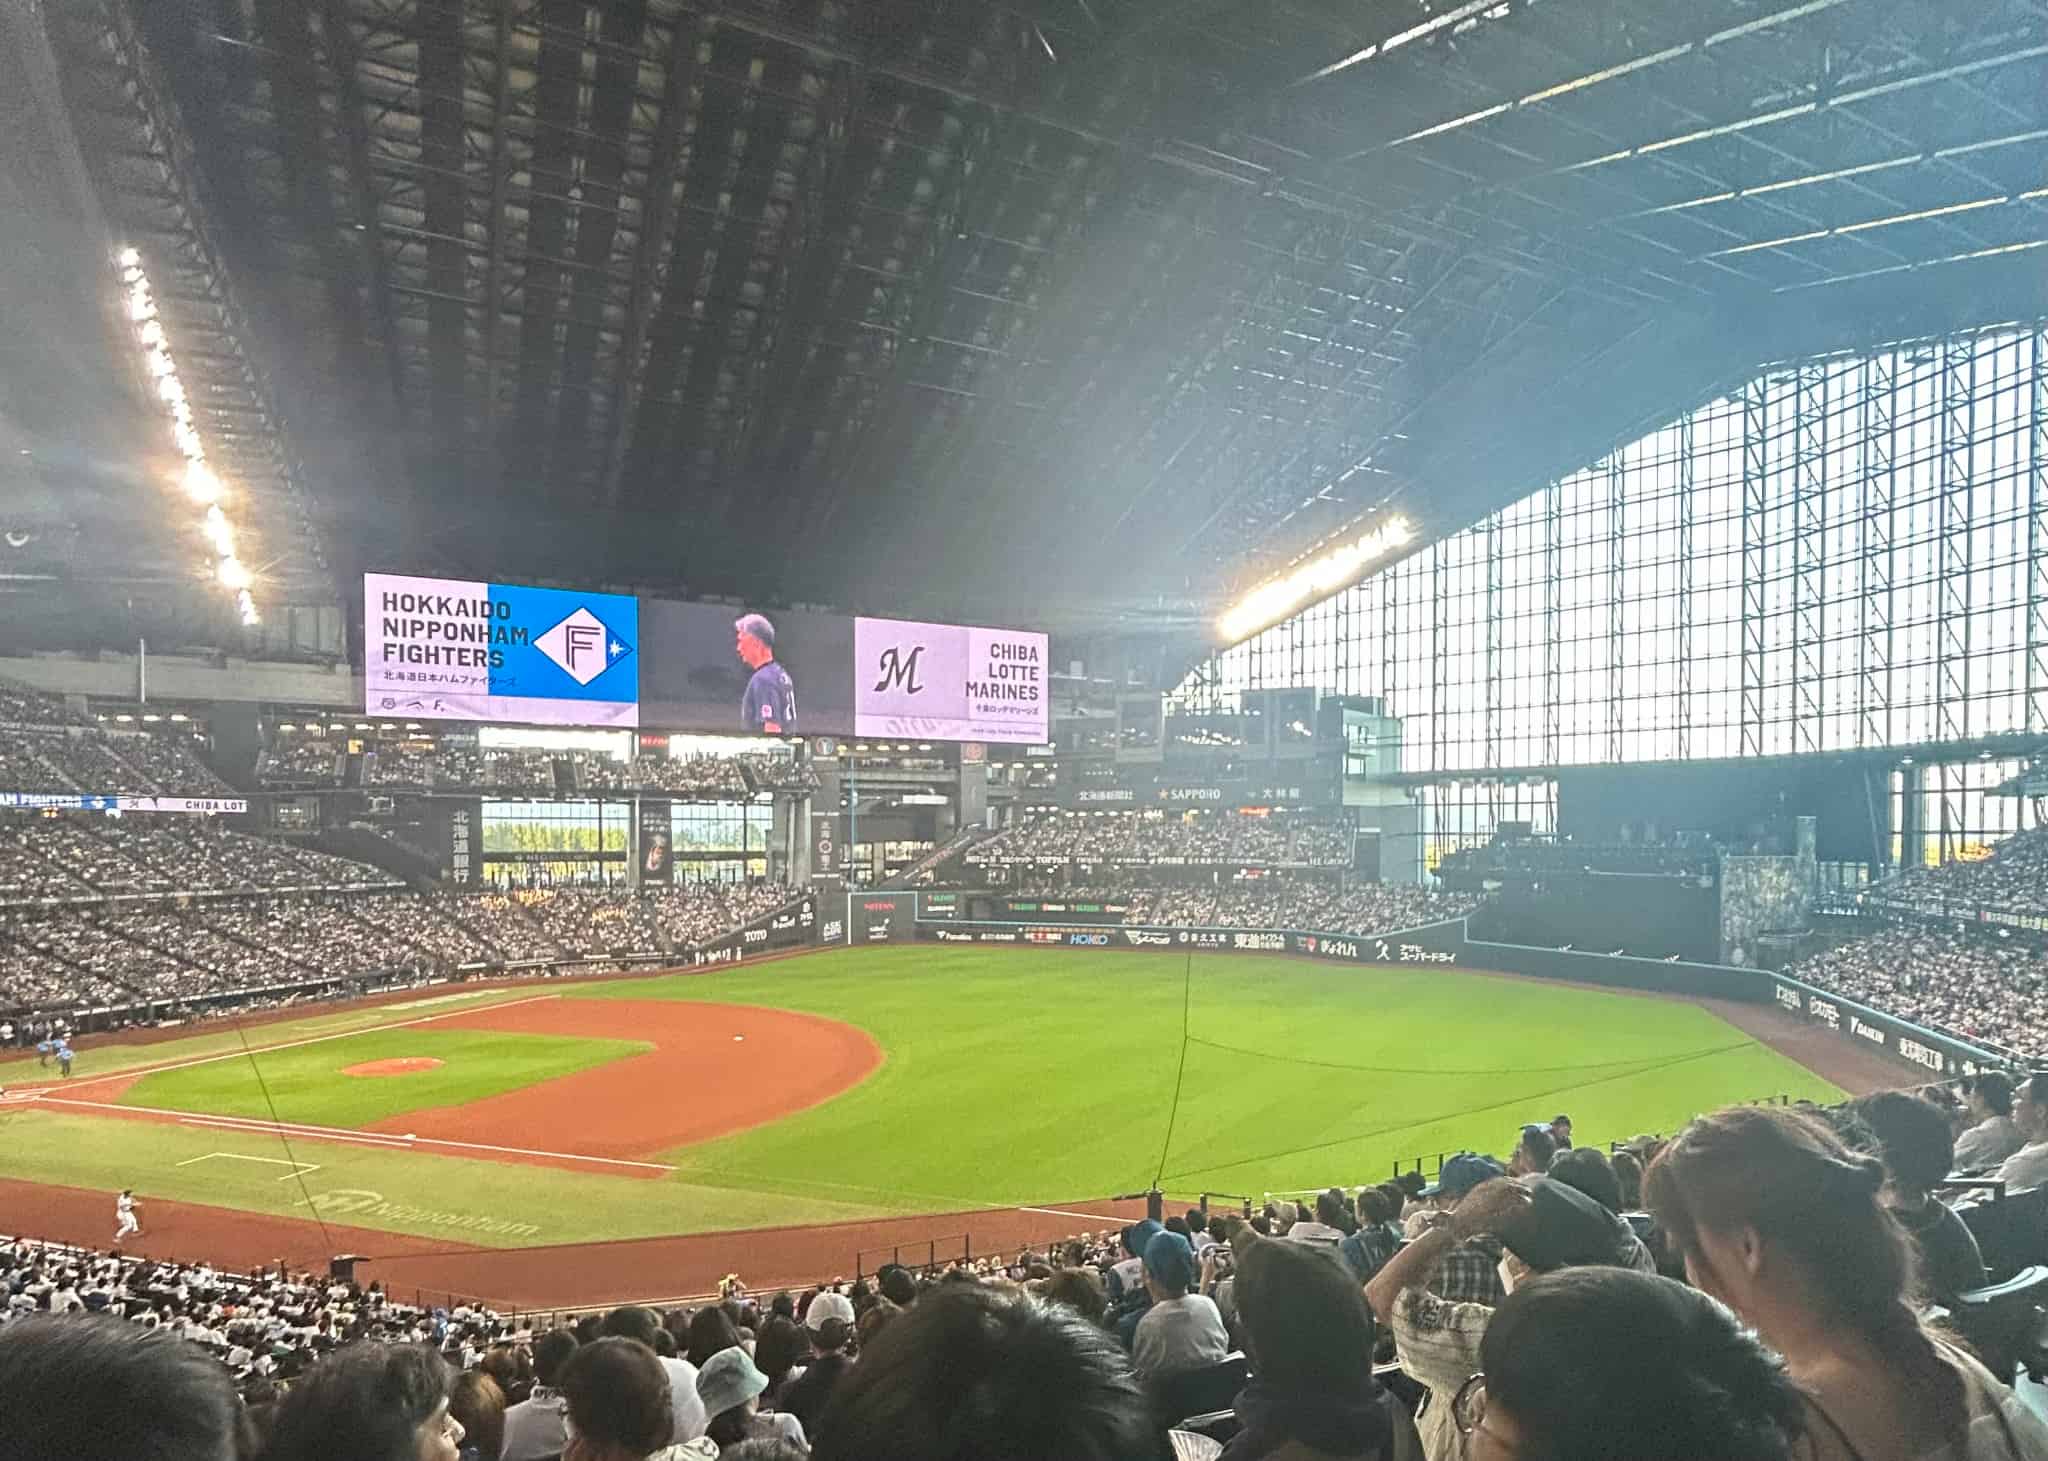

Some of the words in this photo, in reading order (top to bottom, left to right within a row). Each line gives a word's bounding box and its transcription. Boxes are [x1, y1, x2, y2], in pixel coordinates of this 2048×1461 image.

[382, 592, 511, 620] HOKKAIDO
[383, 617, 529, 647] NIPPONHAM
[383, 642, 505, 668] FIGHTERS
[990, 643, 1039, 662] CHIBA
[874, 646, 925, 694] M
[988, 663, 1040, 681] LOTTE
[965, 681, 1039, 701] MARINES
[1171, 788, 1221, 799] SAPPORO
[185, 800, 219, 810] CHIBA
[223, 801, 244, 811] LOT
[745, 929, 768, 942] TOTO
[1400, 952, 1457, 963] スーパードライ
